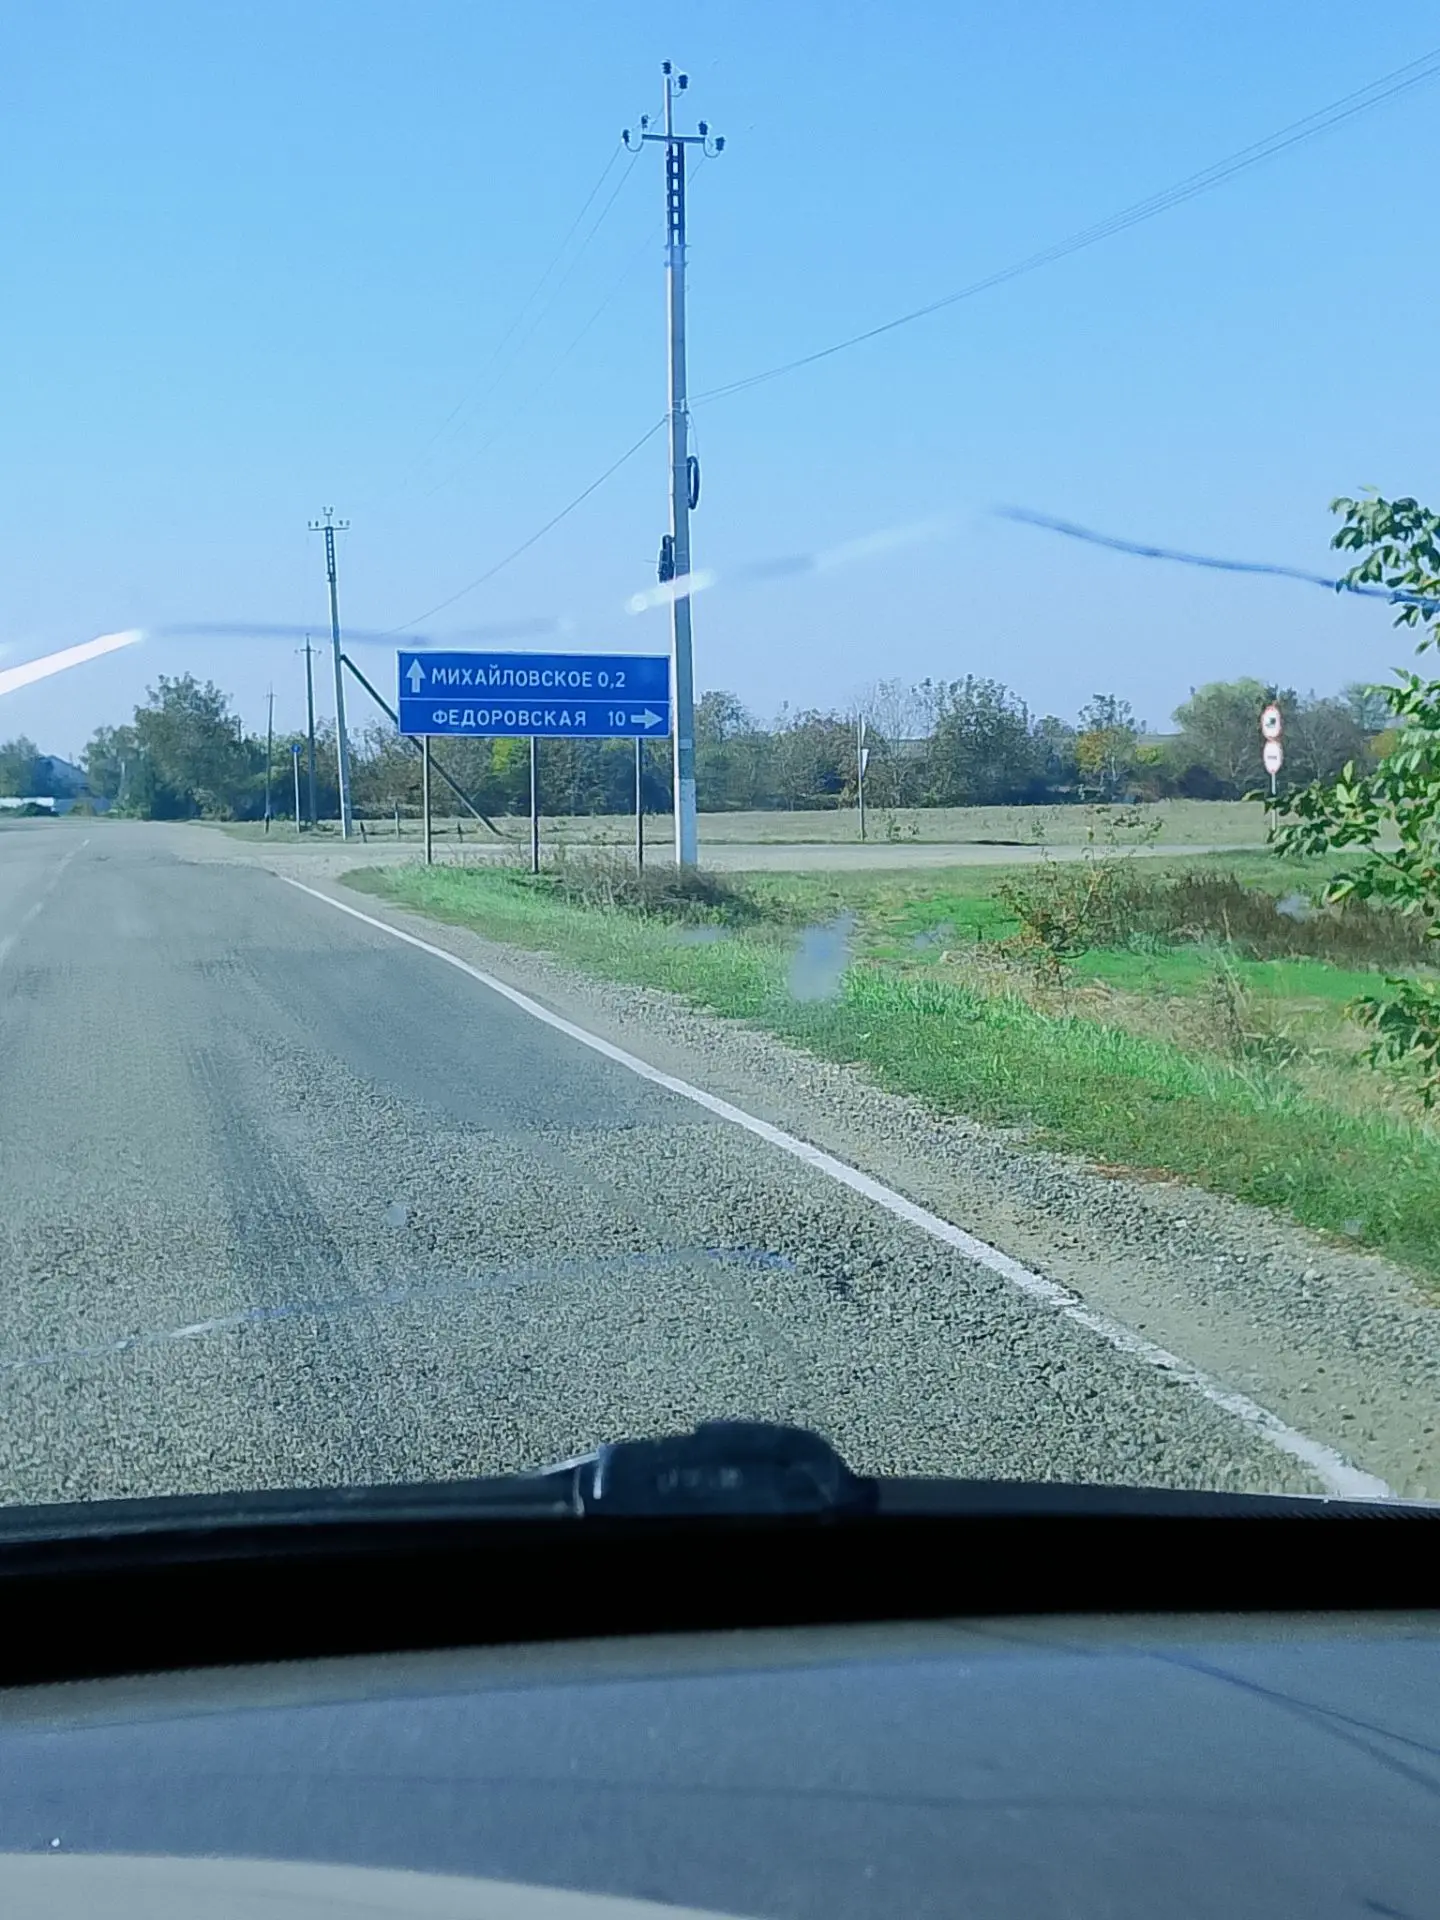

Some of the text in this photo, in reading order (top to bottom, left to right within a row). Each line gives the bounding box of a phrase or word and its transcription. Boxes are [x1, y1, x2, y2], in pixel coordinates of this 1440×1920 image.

[432, 664, 626, 689] МИХАЙЛОВСКОЕ 0,2
[432, 709, 626, 728] ФЕДОРОВСКАЯ 10
